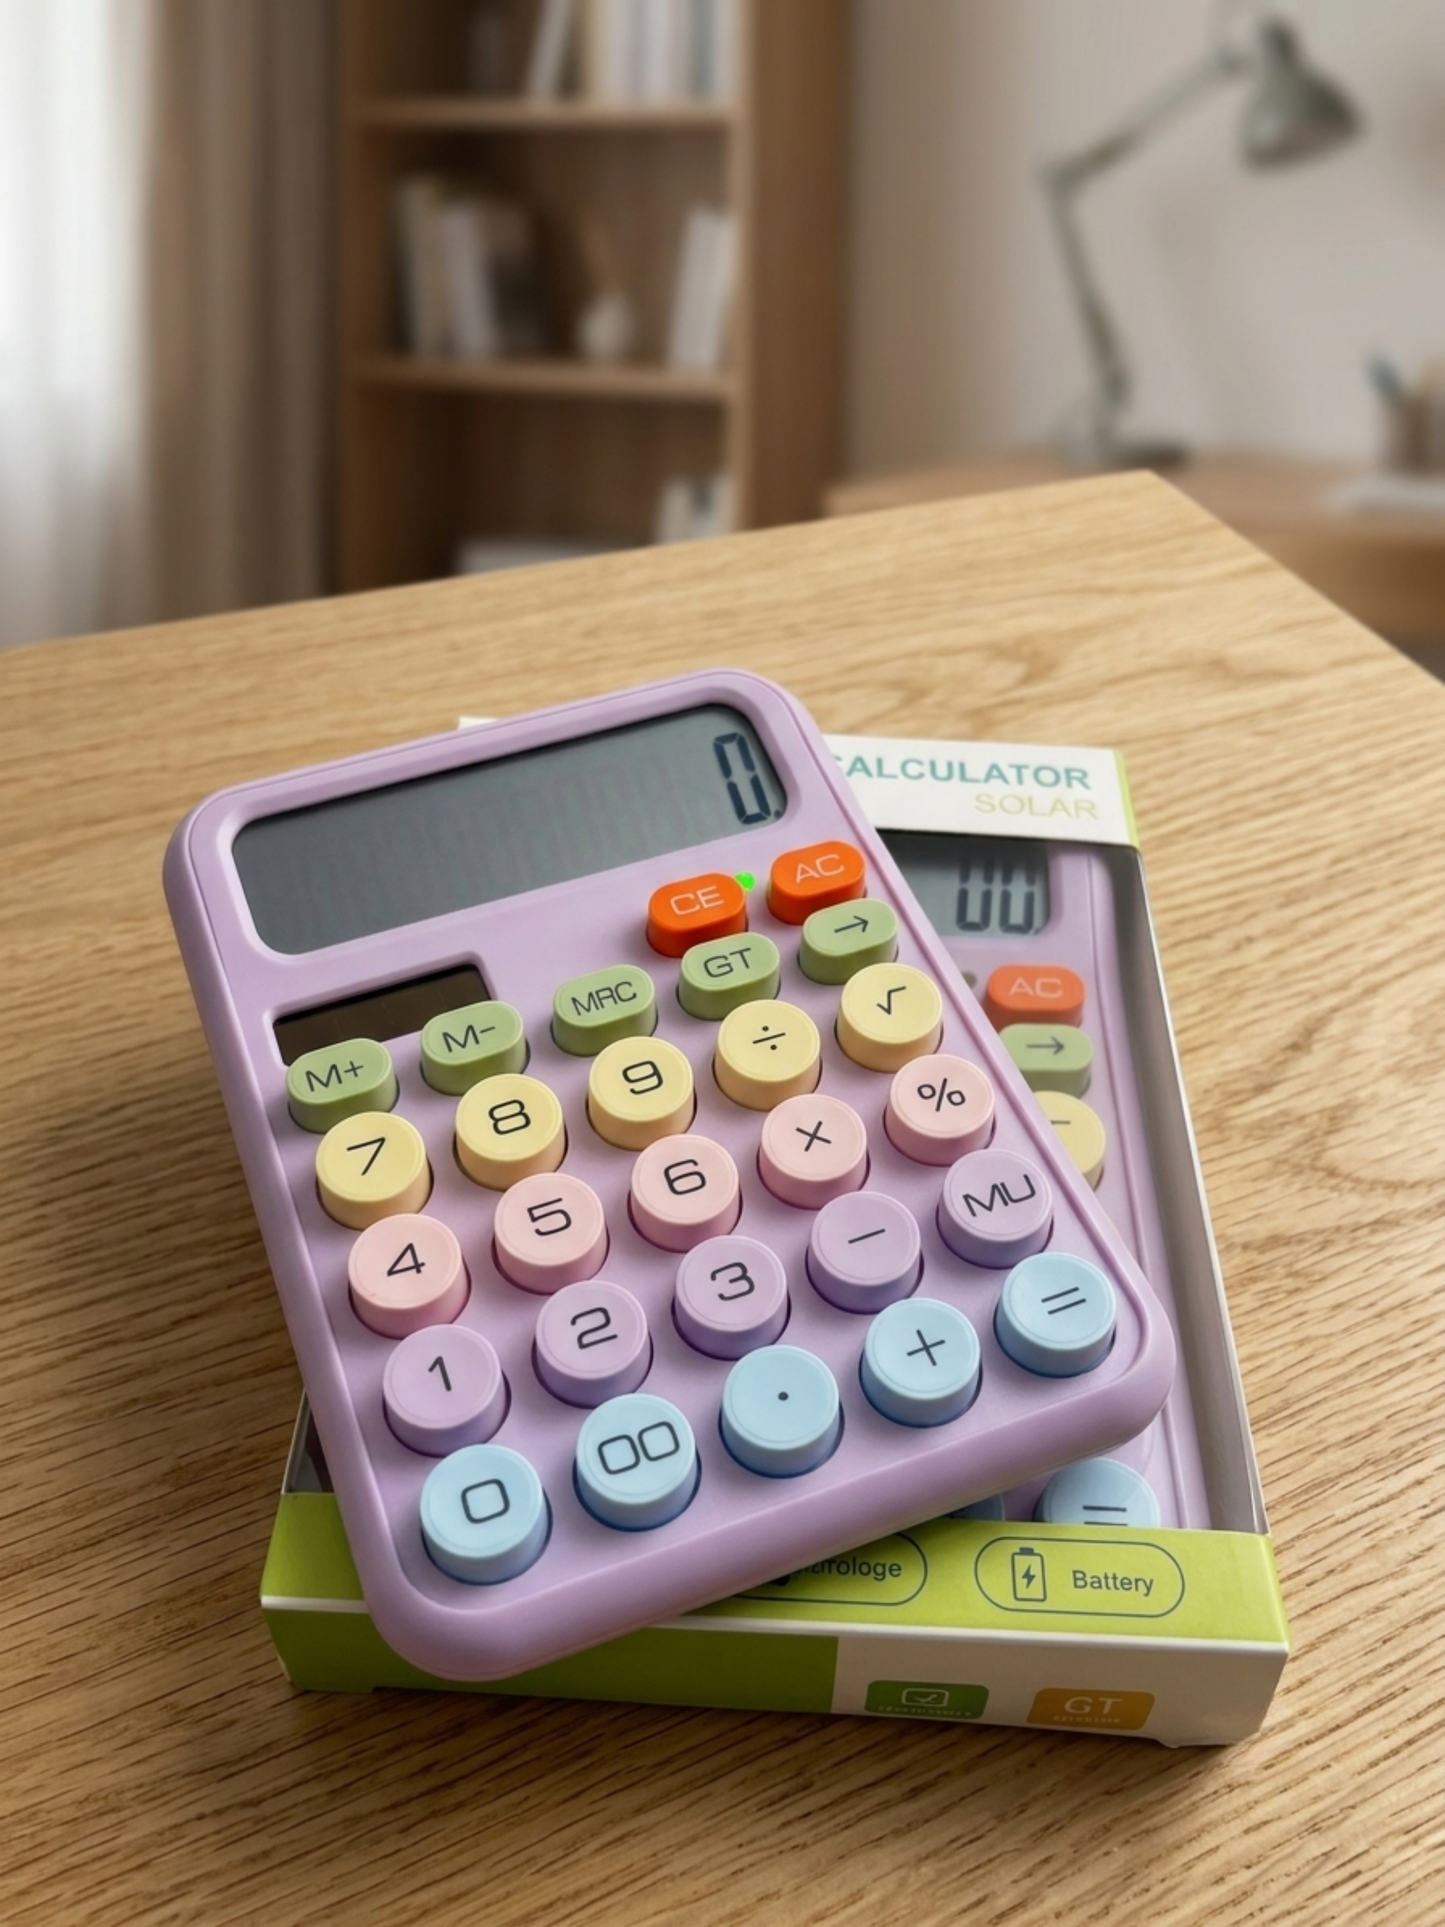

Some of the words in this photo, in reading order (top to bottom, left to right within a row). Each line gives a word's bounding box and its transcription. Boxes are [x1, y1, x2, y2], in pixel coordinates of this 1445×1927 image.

[833, 755, 1092, 790] ALCULATOR
[974, 793, 1099, 820] SOLAR
[795, 854, 845, 884] AC
[670, 886, 724, 915] CE
[703, 947, 752, 978] GT
[570, 981, 637, 1016] MRC
[1009, 976, 1063, 998] AC
[304, 1060, 365, 1092] M+
[621, 1060, 664, 1094] 9
[488, 1099, 532, 1135] 8
[346, 1136, 387, 1176] 7
[663, 1158, 706, 1195] 6
[961, 1173, 1037, 1218] MU
[527, 1198, 572, 1236] 5
[386, 1242, 426, 1277] 4
[710, 1261, 756, 1301] 3
[570, 1307, 618, 1349] 2
[428, 1356, 453, 1392] 1
[597, 1420, 681, 1475] 00
[460, 1478, 511, 1525] 0
[1072, 1570, 1154, 1597] Battery
[1063, 1696, 1122, 1716] GT
